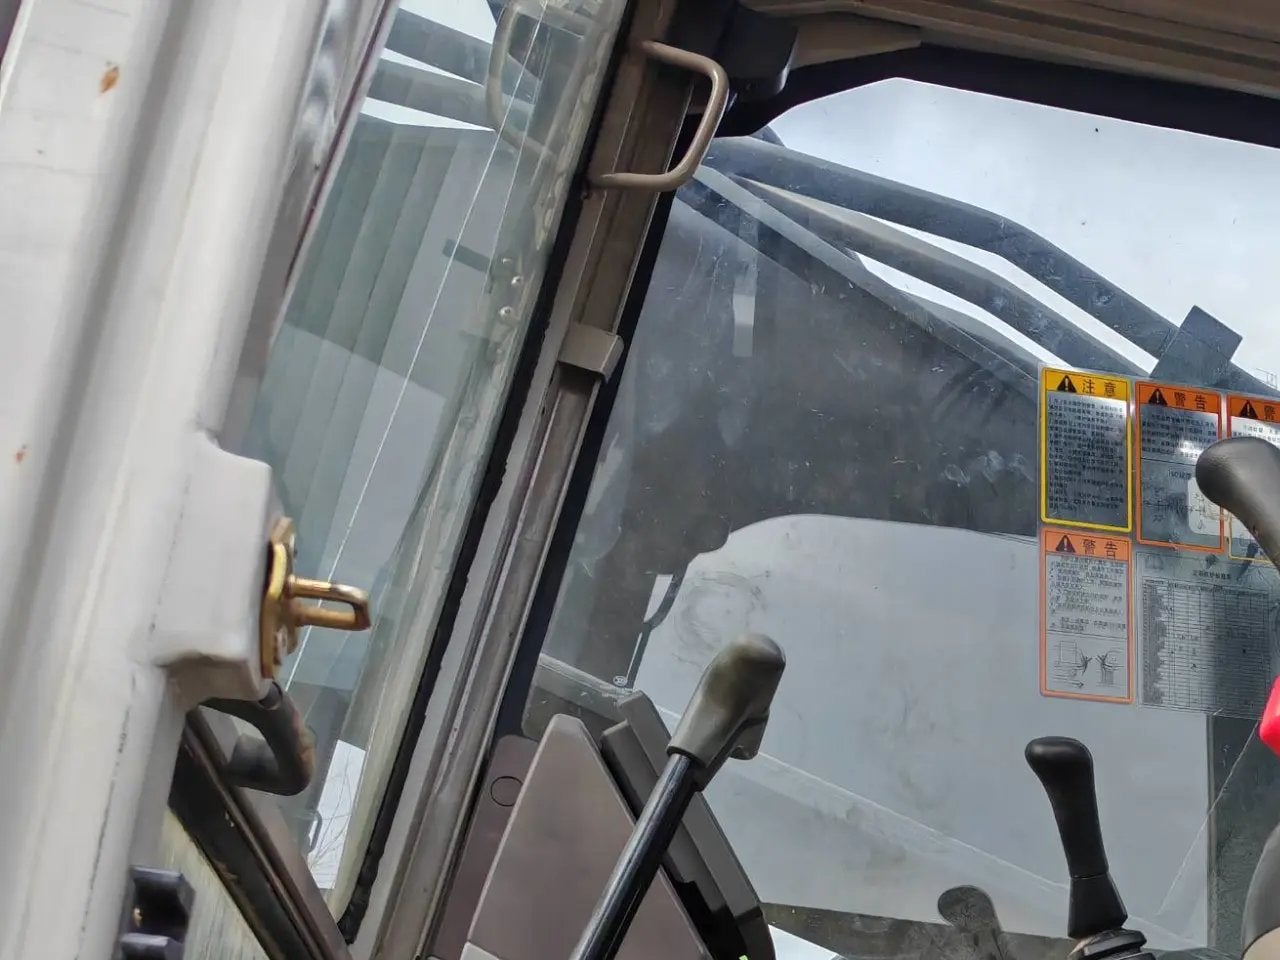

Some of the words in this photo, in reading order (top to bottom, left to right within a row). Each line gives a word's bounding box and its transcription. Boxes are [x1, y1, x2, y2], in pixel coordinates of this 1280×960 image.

[1082, 379, 1116, 397] 注意
[1174, 391, 1207, 410] 警告
[1082, 539, 1118, 560] 警告
